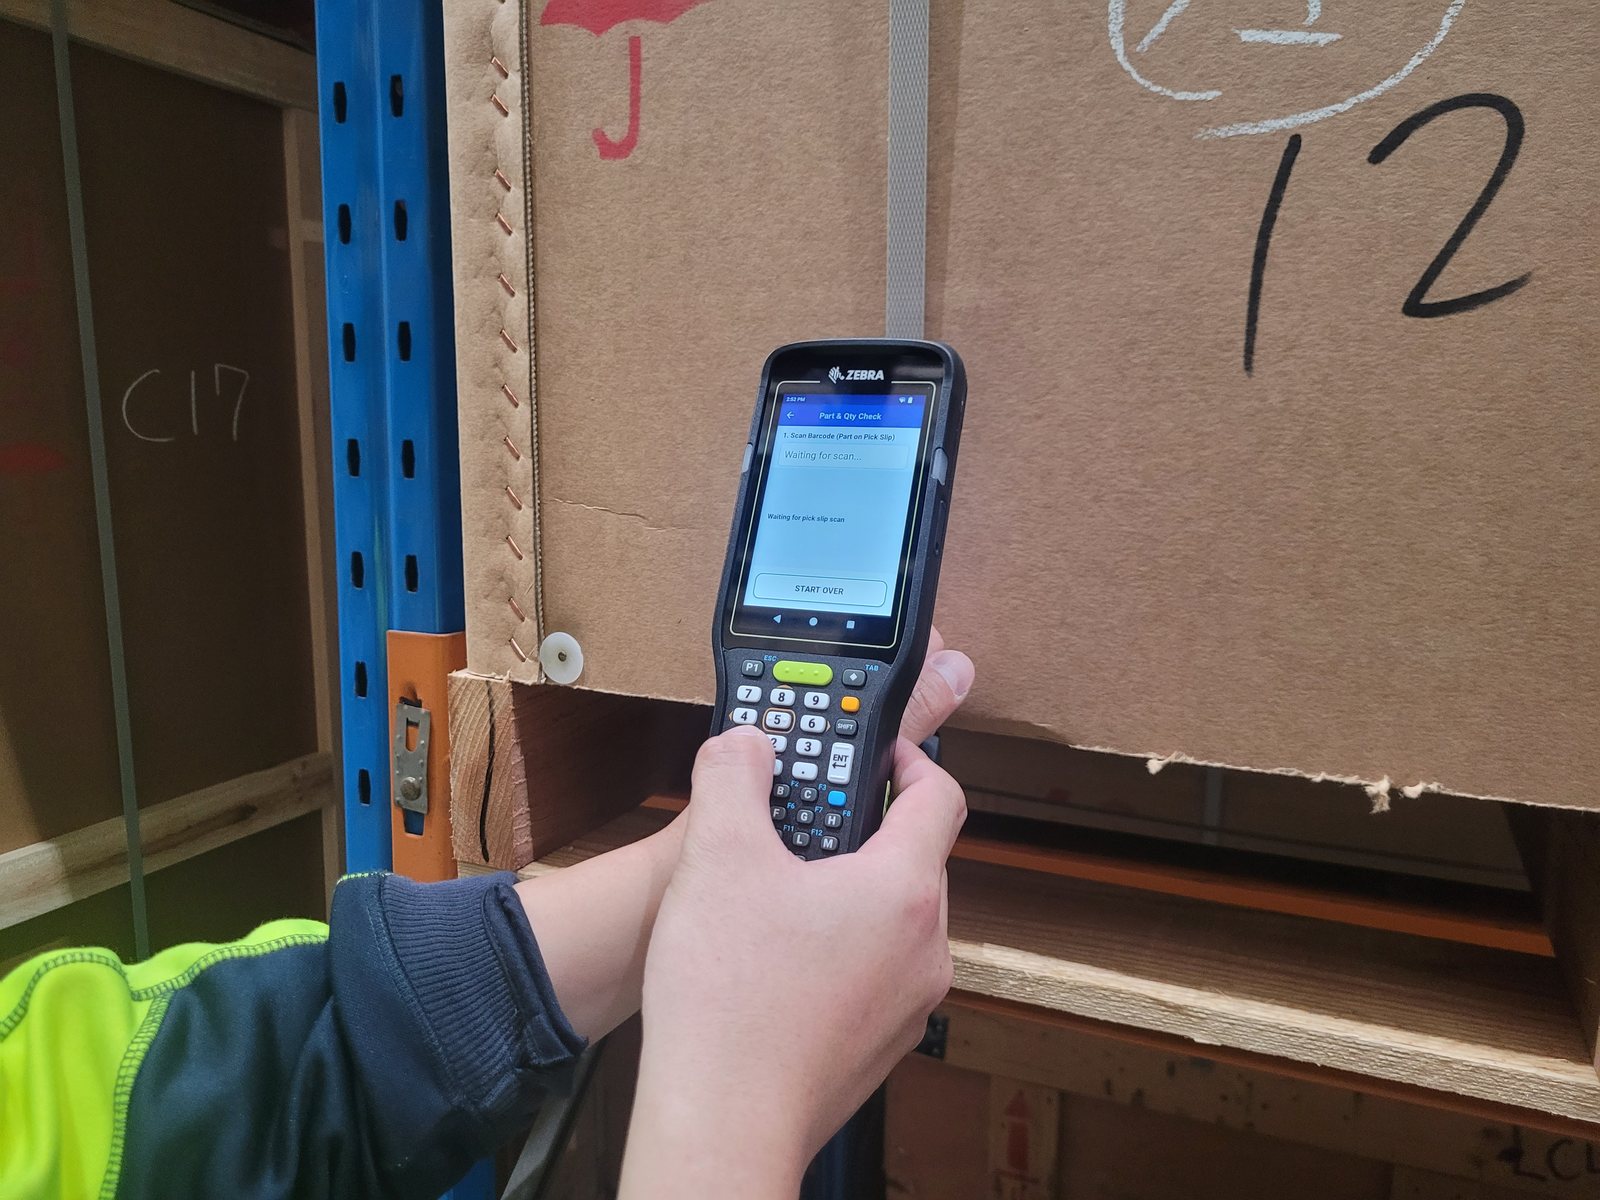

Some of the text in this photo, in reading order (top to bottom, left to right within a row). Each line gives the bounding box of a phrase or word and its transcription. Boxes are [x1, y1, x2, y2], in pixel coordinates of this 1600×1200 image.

[1243, 92, 1535, 379] 12
[845, 369, 885, 381] ZEBRA
[121, 363, 250, 444] C17
[819, 412, 835, 420] Part
[843, 412, 856, 422] Qty
[858, 412, 882, 421] Check
[808, 432, 835, 440] Barcode
[836, 433, 853, 441] (Part
[880, 434, 896, 442] Slip)
[784, 450, 862, 462] Waiting for scan...
[767, 513, 791, 522] Waiting
[802, 515, 816, 523] pick
[816, 515, 829, 523] slip
[794, 584, 844, 595] START OVER
[763, 654, 777, 662] ESC
[745, 663, 759, 673] P1
[864, 664, 879, 672] TAB
[744, 689, 752, 698] 7
[778, 692, 786, 702] 8
[812, 696, 819, 705] 9
[740, 711, 747, 721] 4
[773, 715, 780, 725] 5
[808, 718, 815, 728] 6
[771, 738, 777, 749] 2
[804, 742, 811, 751] 3
[832, 754, 849, 763] ENT
[777, 787, 784, 795] B
[818, 783, 827, 791] F3
[804, 790, 812, 799] C
[773, 809, 780, 817] F
[800, 812, 808, 821] G
[828, 816, 836, 825] H
[811, 828, 823, 836] F12
[796, 835, 803, 844] L
[823, 838, 833, 848] M
